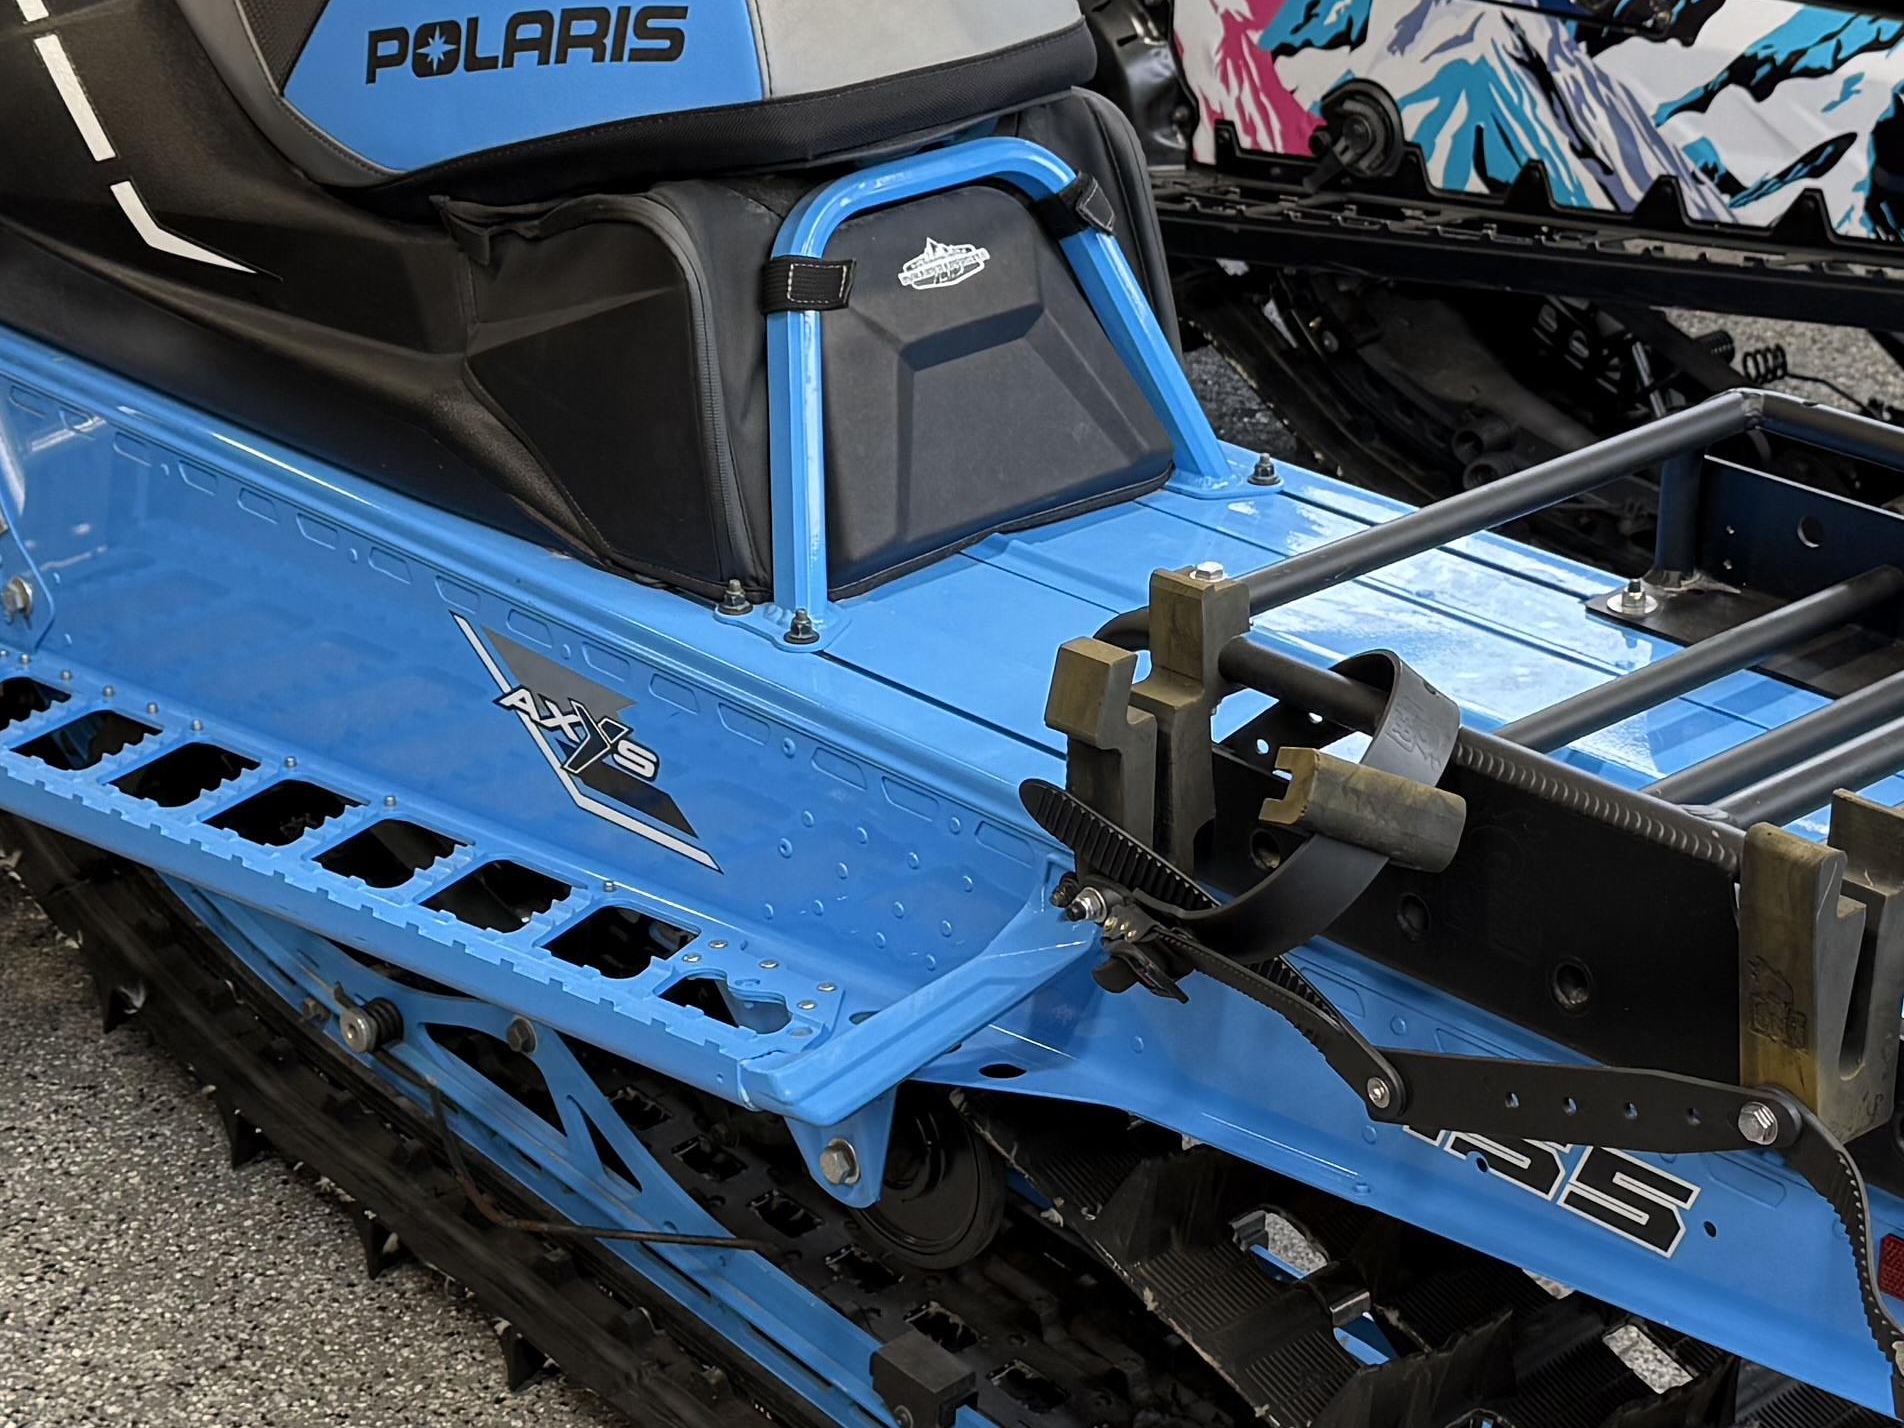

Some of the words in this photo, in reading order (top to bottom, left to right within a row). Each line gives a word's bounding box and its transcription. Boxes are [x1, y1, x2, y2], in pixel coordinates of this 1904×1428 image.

[365, 5, 689, 84] POLARIS
[493, 685, 660, 782] AXYS
[1402, 1125, 1701, 1259] 55
